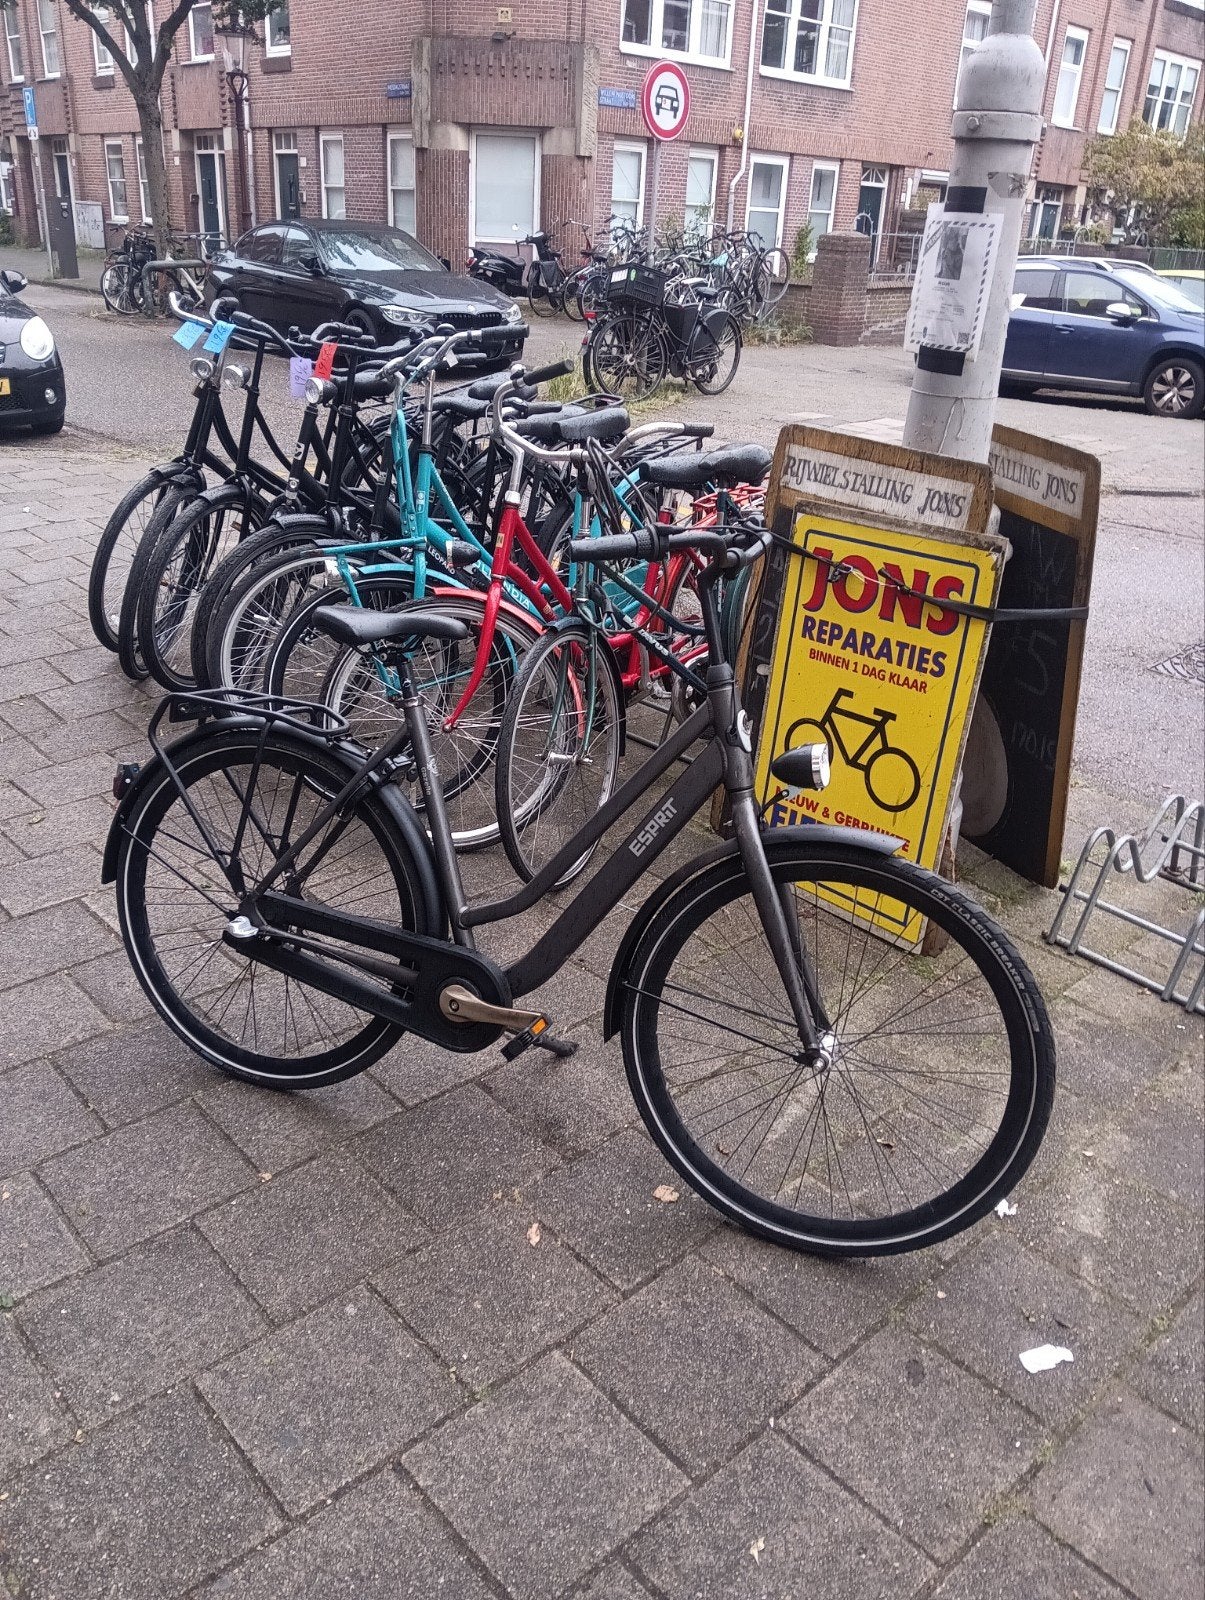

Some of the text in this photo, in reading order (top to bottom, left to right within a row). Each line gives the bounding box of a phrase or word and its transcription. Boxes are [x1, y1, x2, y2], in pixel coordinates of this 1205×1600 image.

[917, 486, 967, 518] JONS
[801, 546, 965, 636] JONS
[801, 615, 947, 679] REPARATIES
[809, 648, 928, 694] BINNEN 1 DAG KLAAR
[821, 806, 830, 819] &
[951, 903, 992, 940] CLASSIC
[992, 940, 1025, 990] BREAKER
